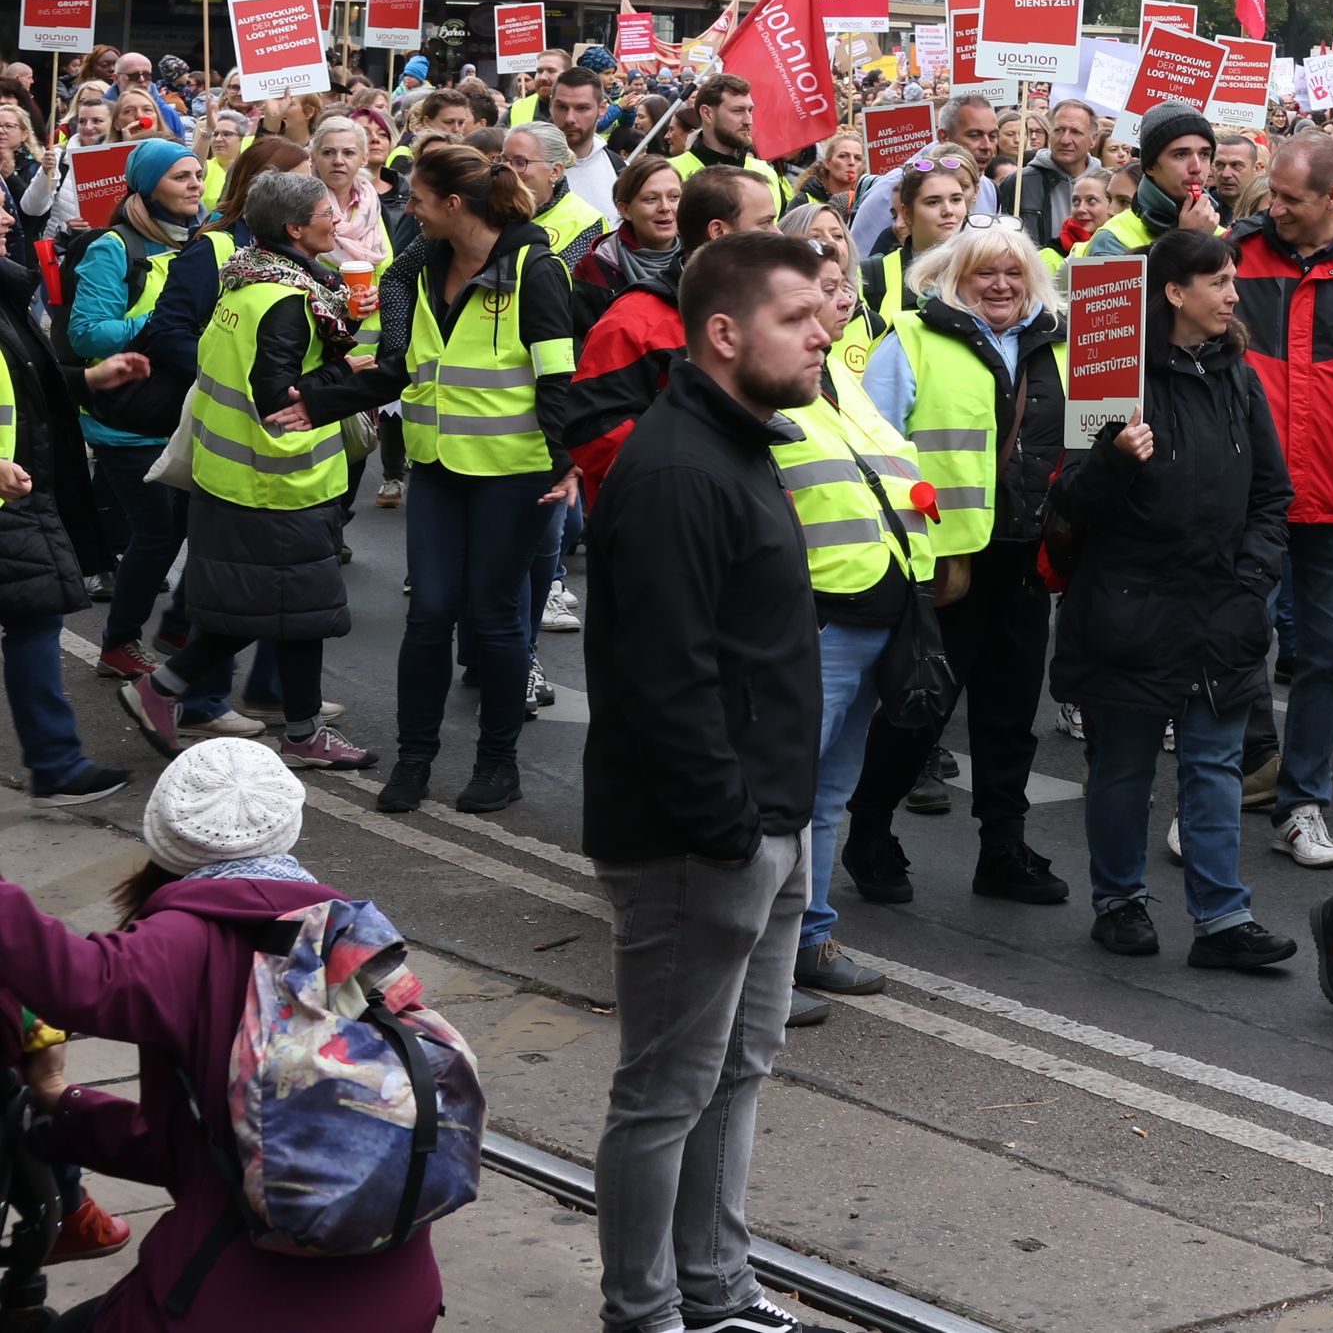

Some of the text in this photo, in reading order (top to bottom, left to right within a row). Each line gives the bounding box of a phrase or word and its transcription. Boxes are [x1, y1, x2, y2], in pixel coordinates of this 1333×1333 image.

[237, 5, 305, 26] AUFSTOCKUNG
[252, 13, 313, 32] DER PSYCHO-
[1144, 15, 1183, 23] REINIGUNGS-
[35, 33, 79, 43] younion
[254, 37, 316, 57] 13 PERSONEN
[274, 35, 289, 44] UM
[376, 33, 410, 43] younion
[997, 51, 1058, 66] younion
[1147, 48, 1212, 69] AUFSTOCKUNG
[1157, 59, 1214, 79] DER PSYCHO-
[259, 72, 311, 91] younion
[1168, 83, 1183, 93] UM
[1146, 88, 1204, 108] 13 PERSONEN
[1217, 107, 1254, 118] younion
[867, 129, 934, 149] WEITERBILDUNGS-
[878, 123, 914, 138] AUS- UND
[879, 140, 927, 156] OFFENSIVEN
[886, 155, 894, 164] IN
[77, 174, 127, 192] EINHEITLIC
[77, 184, 128, 202] BUNDESRA
[1070, 276, 1143, 302] ADMINISTRATIVES
[1085, 295, 1132, 314] PERSONAL,
[1091, 312, 1120, 329] UM DIE
[1087, 348, 1099, 361] ZU
[1073, 355, 1138, 378] UNTERSTÜTZEN
